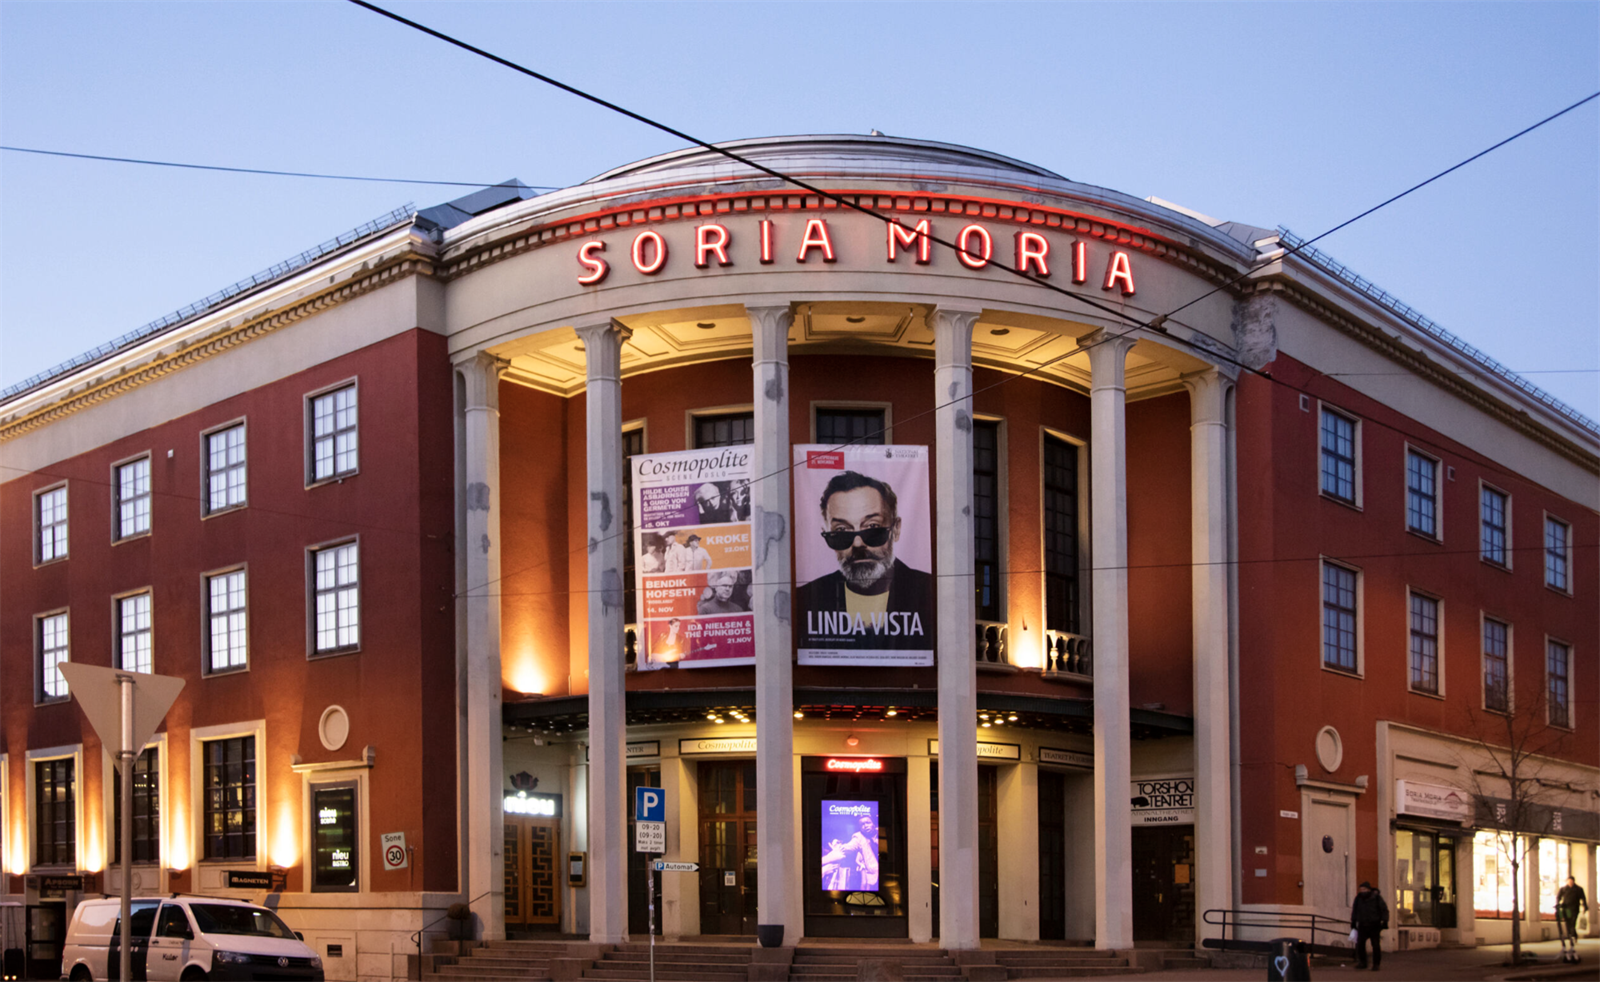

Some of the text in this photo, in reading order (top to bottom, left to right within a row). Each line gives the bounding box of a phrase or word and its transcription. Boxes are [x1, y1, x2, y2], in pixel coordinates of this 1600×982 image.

[577, 218, 1137, 297] SORIA MORIA
[638, 448, 748, 479] Cosmopolite
[666, 474, 693, 482] SCENE
[643, 488, 663, 496] HILDE
[643, 503, 682, 512] GERMETEN
[655, 520, 670, 528] OKT
[706, 533, 749, 545] KROKE
[645, 578, 687, 589] BENDIK
[645, 588, 696, 599] HOFSETH
[687, 623, 703, 631] IDA
[705, 621, 743, 629] NIELSEN
[807, 610, 924, 636] LINDA VISTA
[684, 627, 752, 638] THE FUNKBOTS
[697, 740, 757, 751] Cosmopolite
[827, 759, 882, 772] Cosmopolite
[643, 791, 659, 818] P
[1148, 793, 1194, 808] TEATRET
[829, 804, 871, 815] Cosmopolite
[1131, 809, 1194, 817] ATIONALTHEATRET
[1143, 815, 1179, 823] INNGANG
[384, 834, 402, 843] Sone
[389, 849, 402, 862] 30
[665, 863, 693, 871] Automat
[231, 876, 269, 885] MAGNETEN
